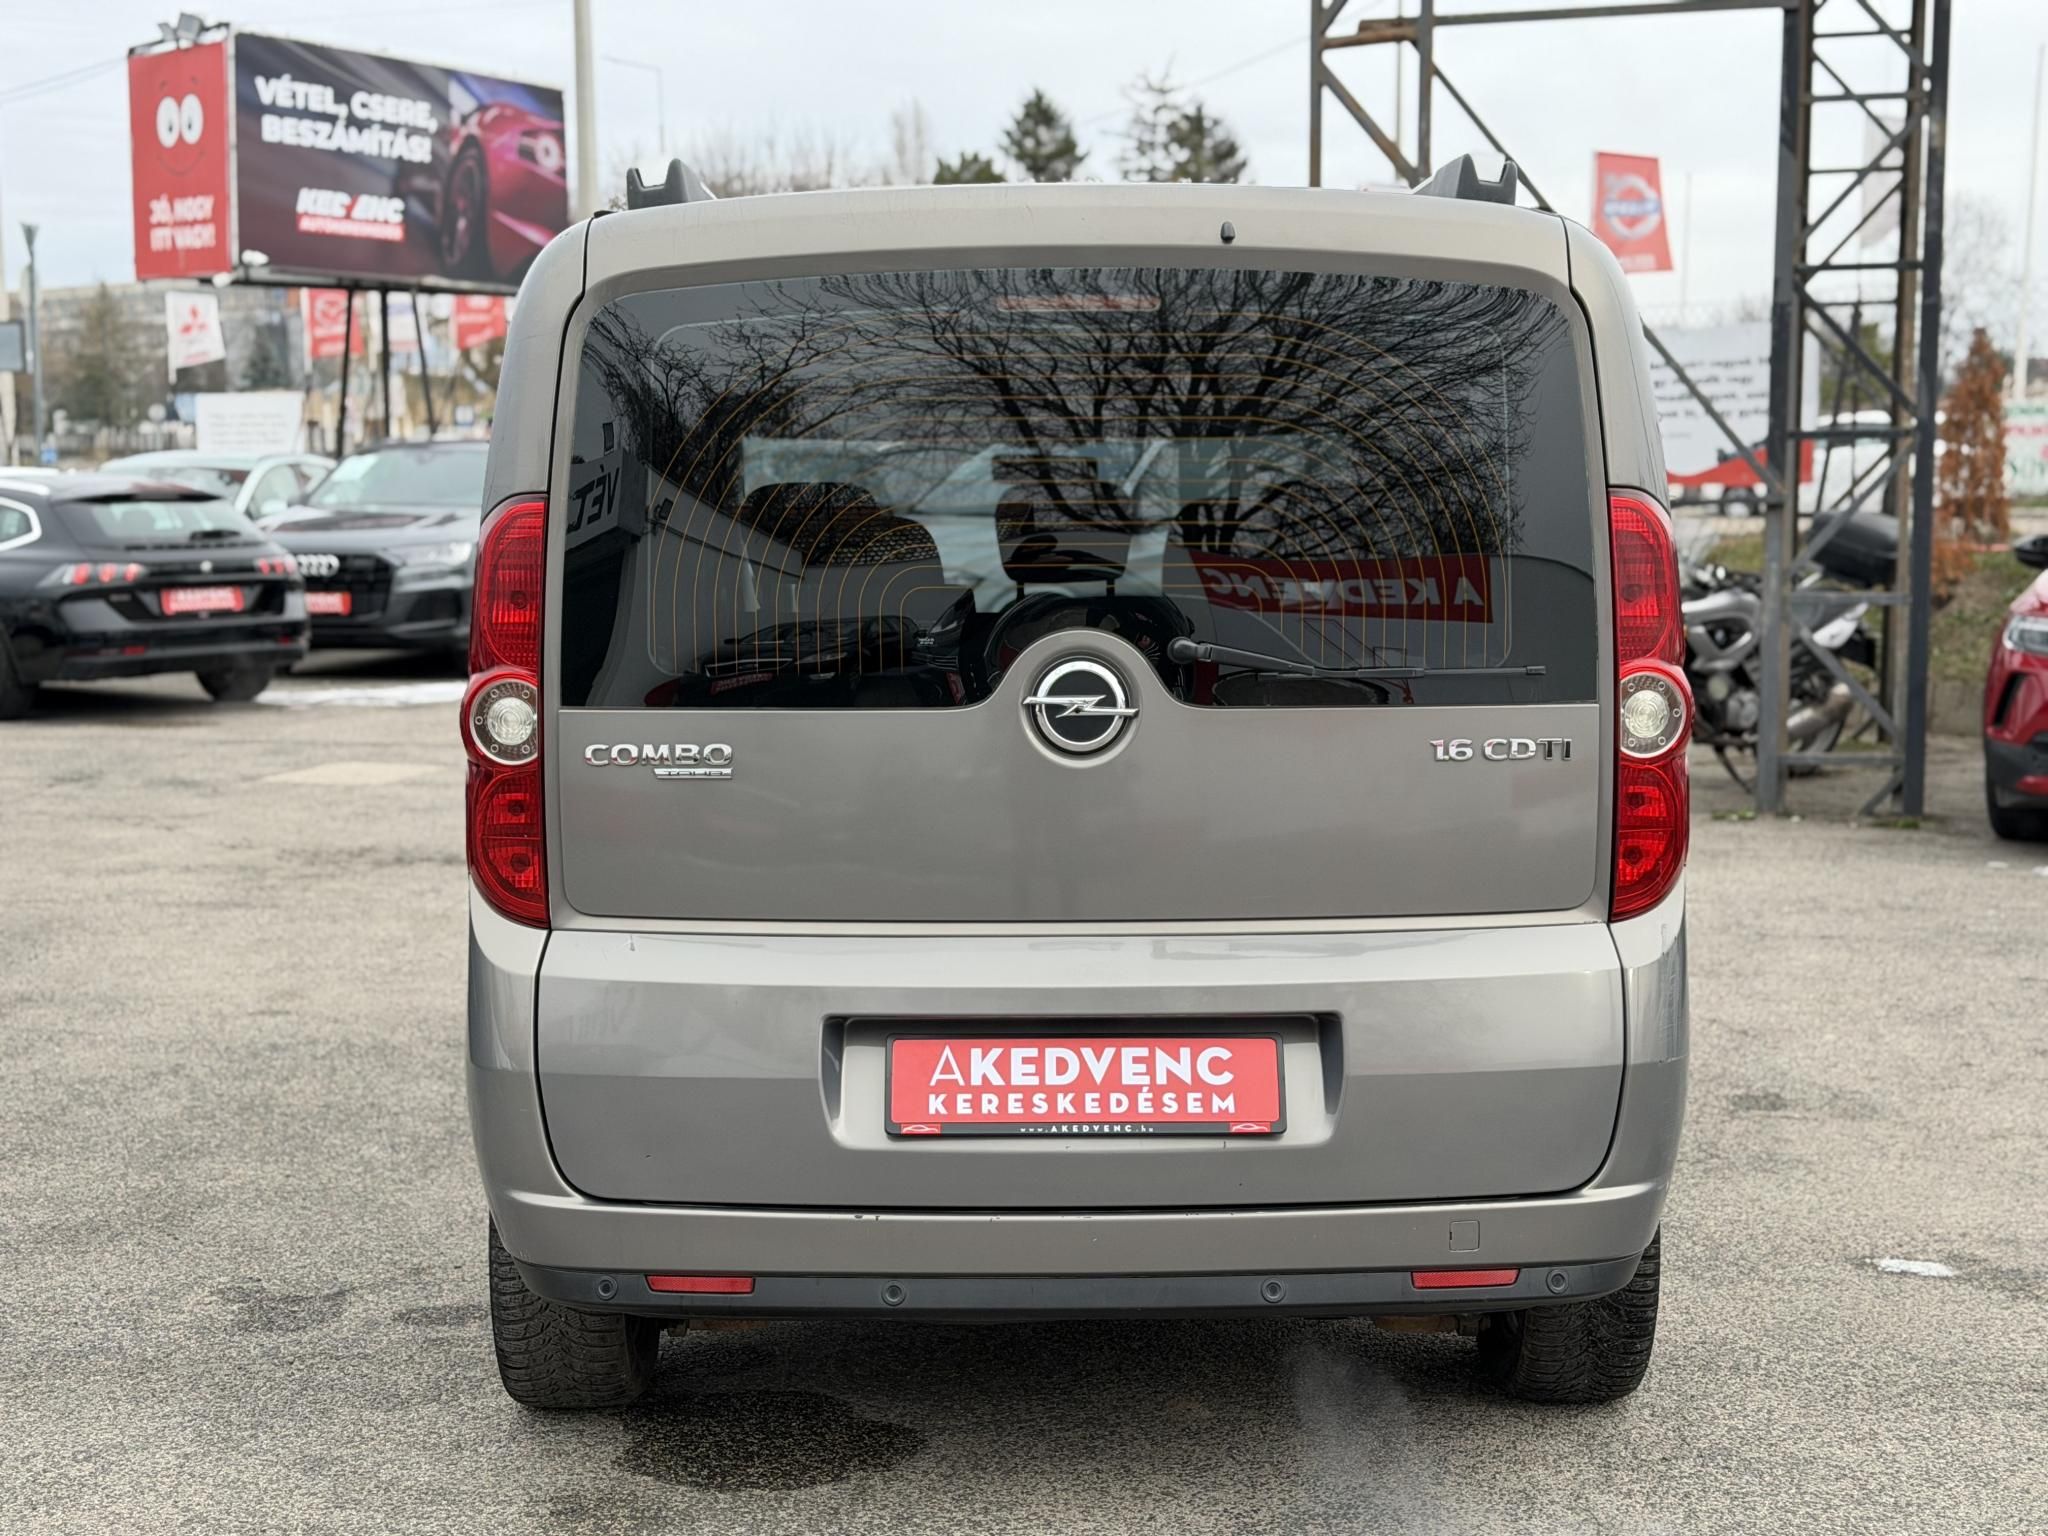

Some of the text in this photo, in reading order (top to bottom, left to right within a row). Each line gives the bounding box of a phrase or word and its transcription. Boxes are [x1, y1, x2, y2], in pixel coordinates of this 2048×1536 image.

[254, 73, 438, 134] VÉTEL, CSERE,
[261, 113, 432, 163] BESZÁMÍTÁS!
[584, 743, 733, 766] COMBO
[1429, 738, 1573, 762] 1.6 CDTI
[928, 1087, 1236, 1116] KERESKEDÉSEM
